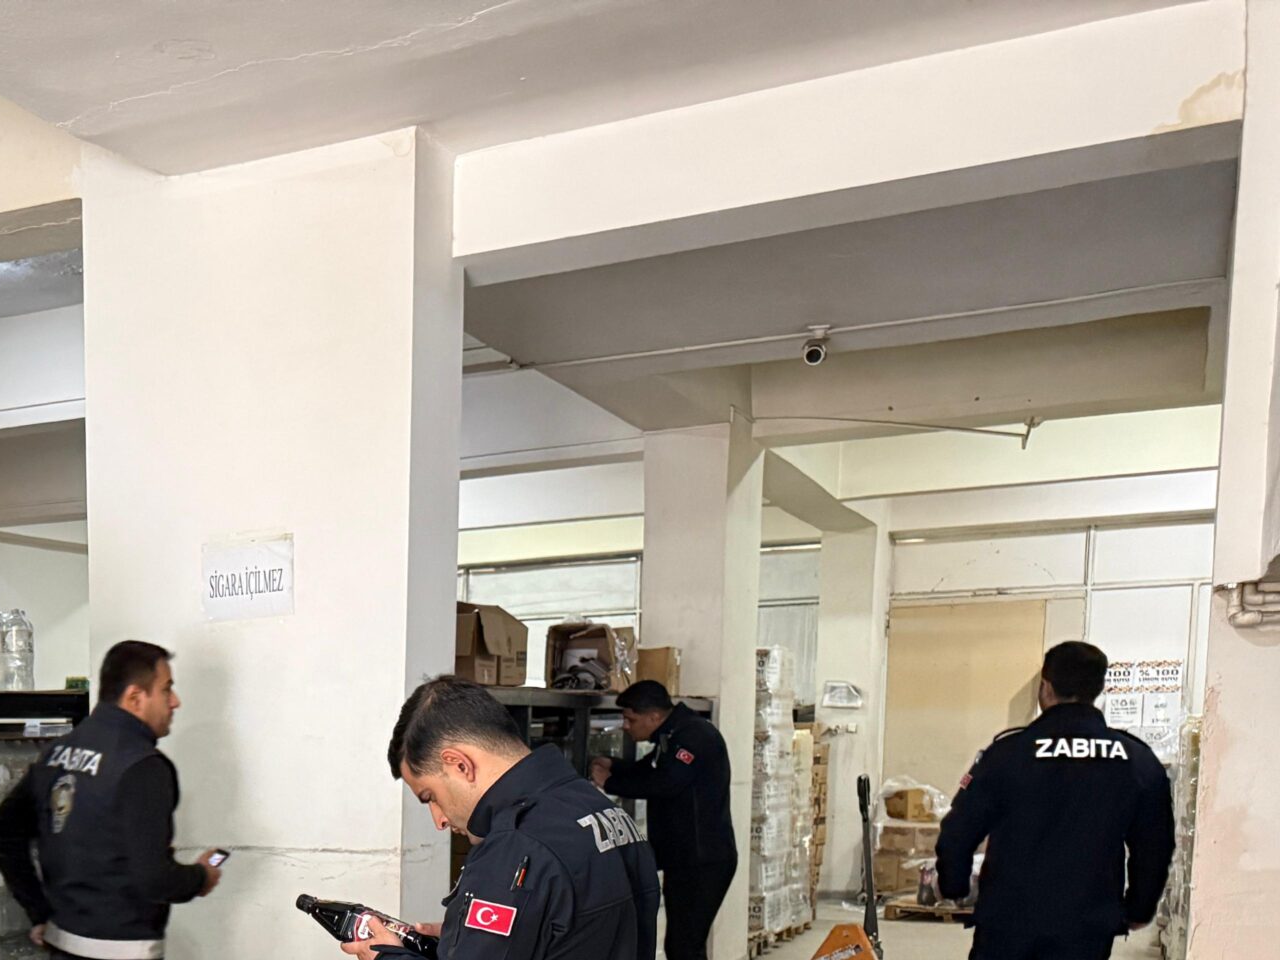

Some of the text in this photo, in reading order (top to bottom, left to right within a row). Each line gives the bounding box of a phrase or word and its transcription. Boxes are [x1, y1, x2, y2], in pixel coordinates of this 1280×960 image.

[209, 565, 283, 600] SİGARA İÇİLMEZ
[47, 744, 102, 776] ZABITA
[1035, 738, 1128, 760] ZABITA
